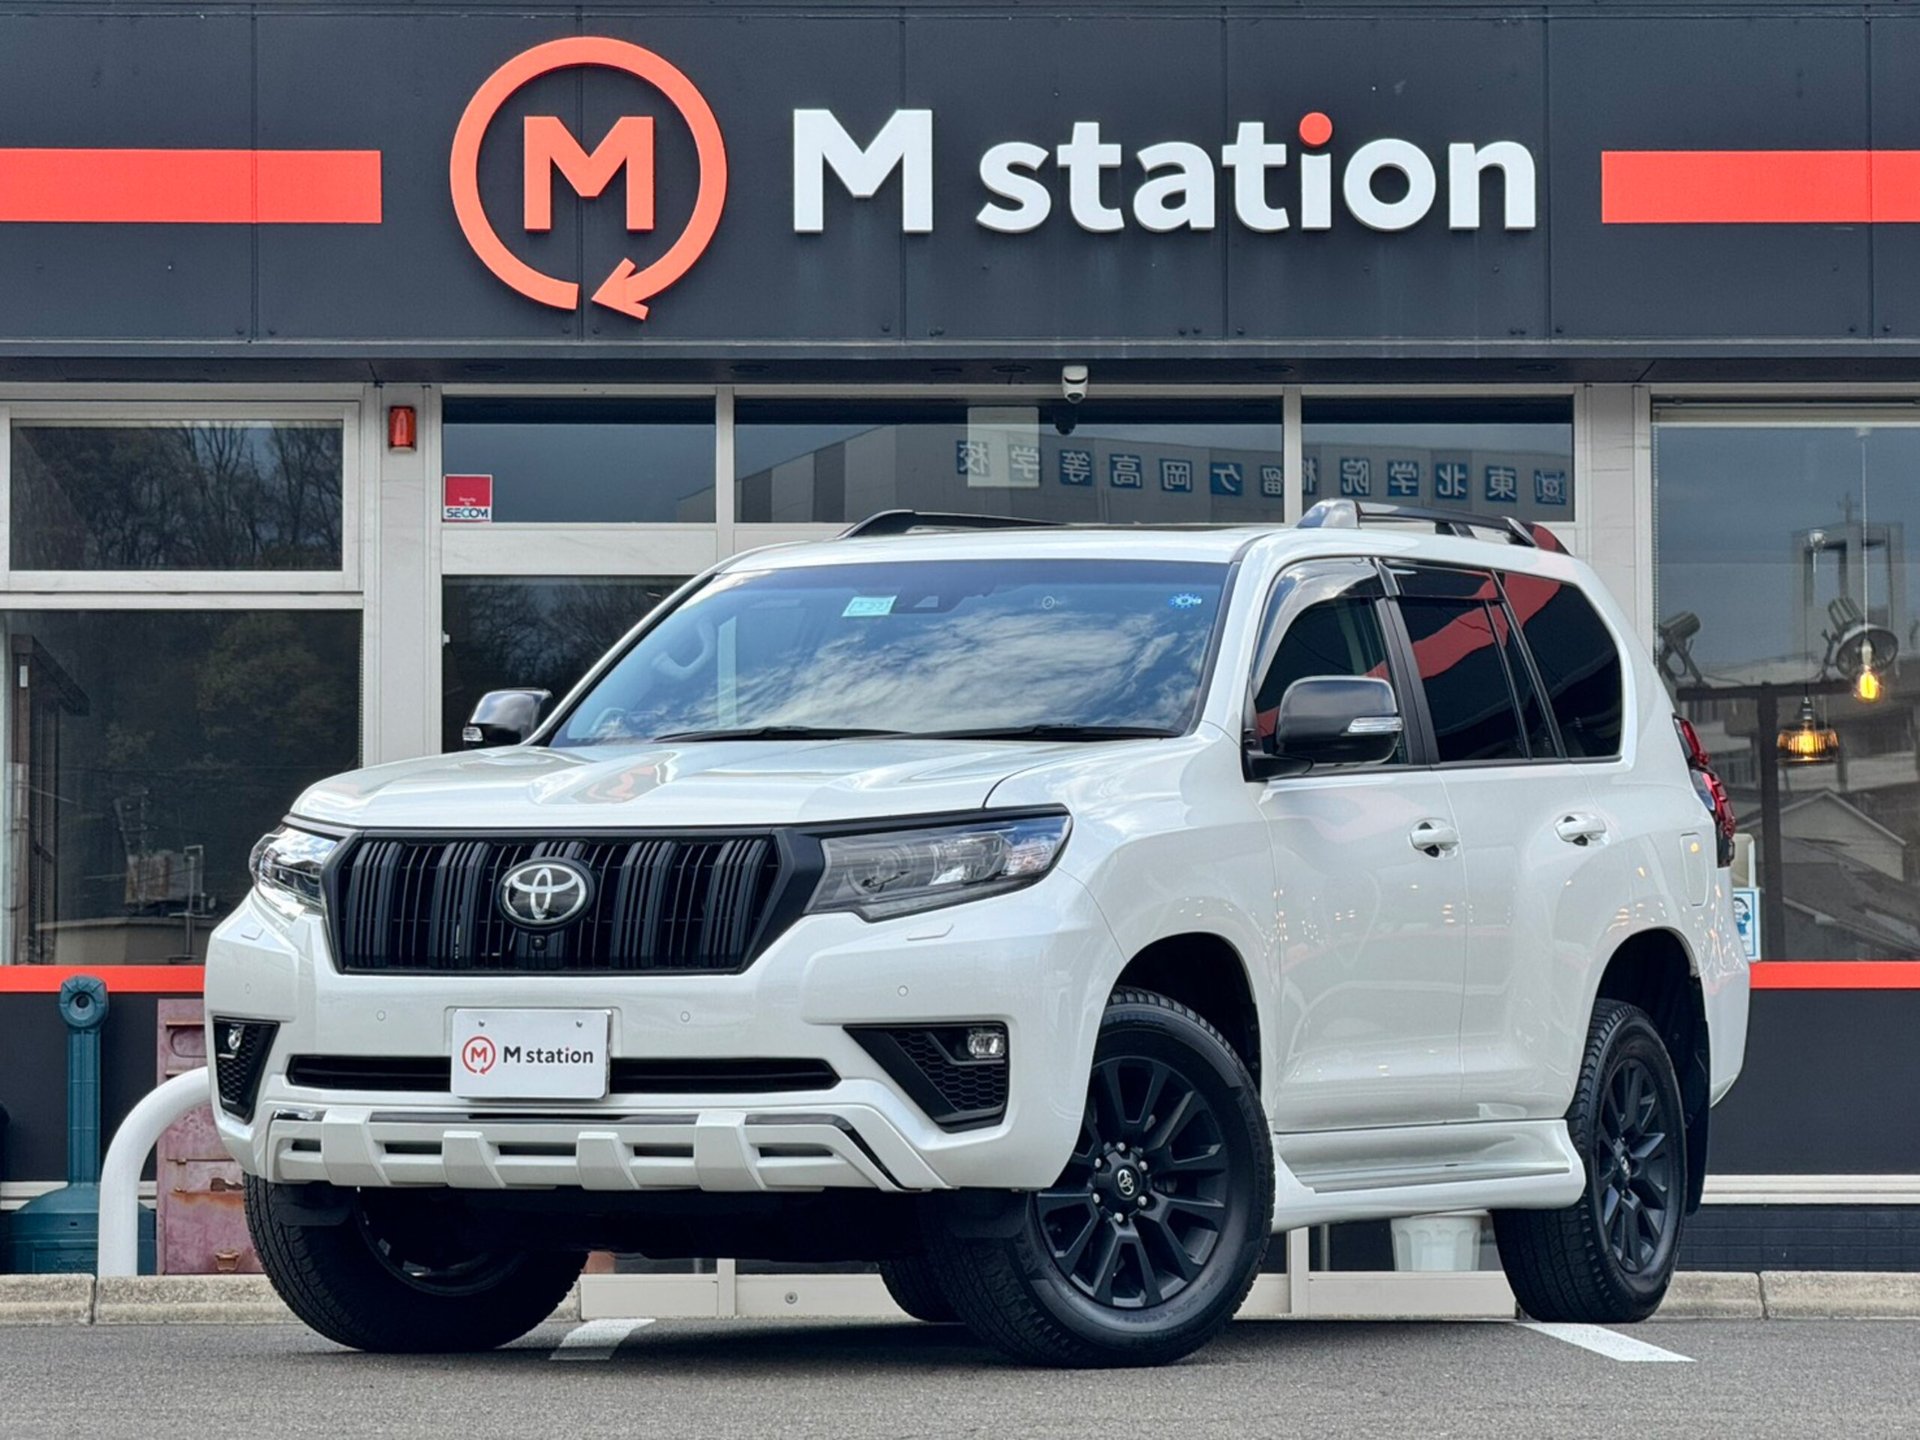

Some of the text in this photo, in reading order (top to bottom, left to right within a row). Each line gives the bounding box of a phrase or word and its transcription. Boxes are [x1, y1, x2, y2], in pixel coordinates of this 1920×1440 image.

[523, 115, 656, 231] M
[792, 108, 1537, 232] M station
[446, 507, 488, 518] SECOM
[470, 1046, 488, 1063] M
[503, 1046, 594, 1063] M station
